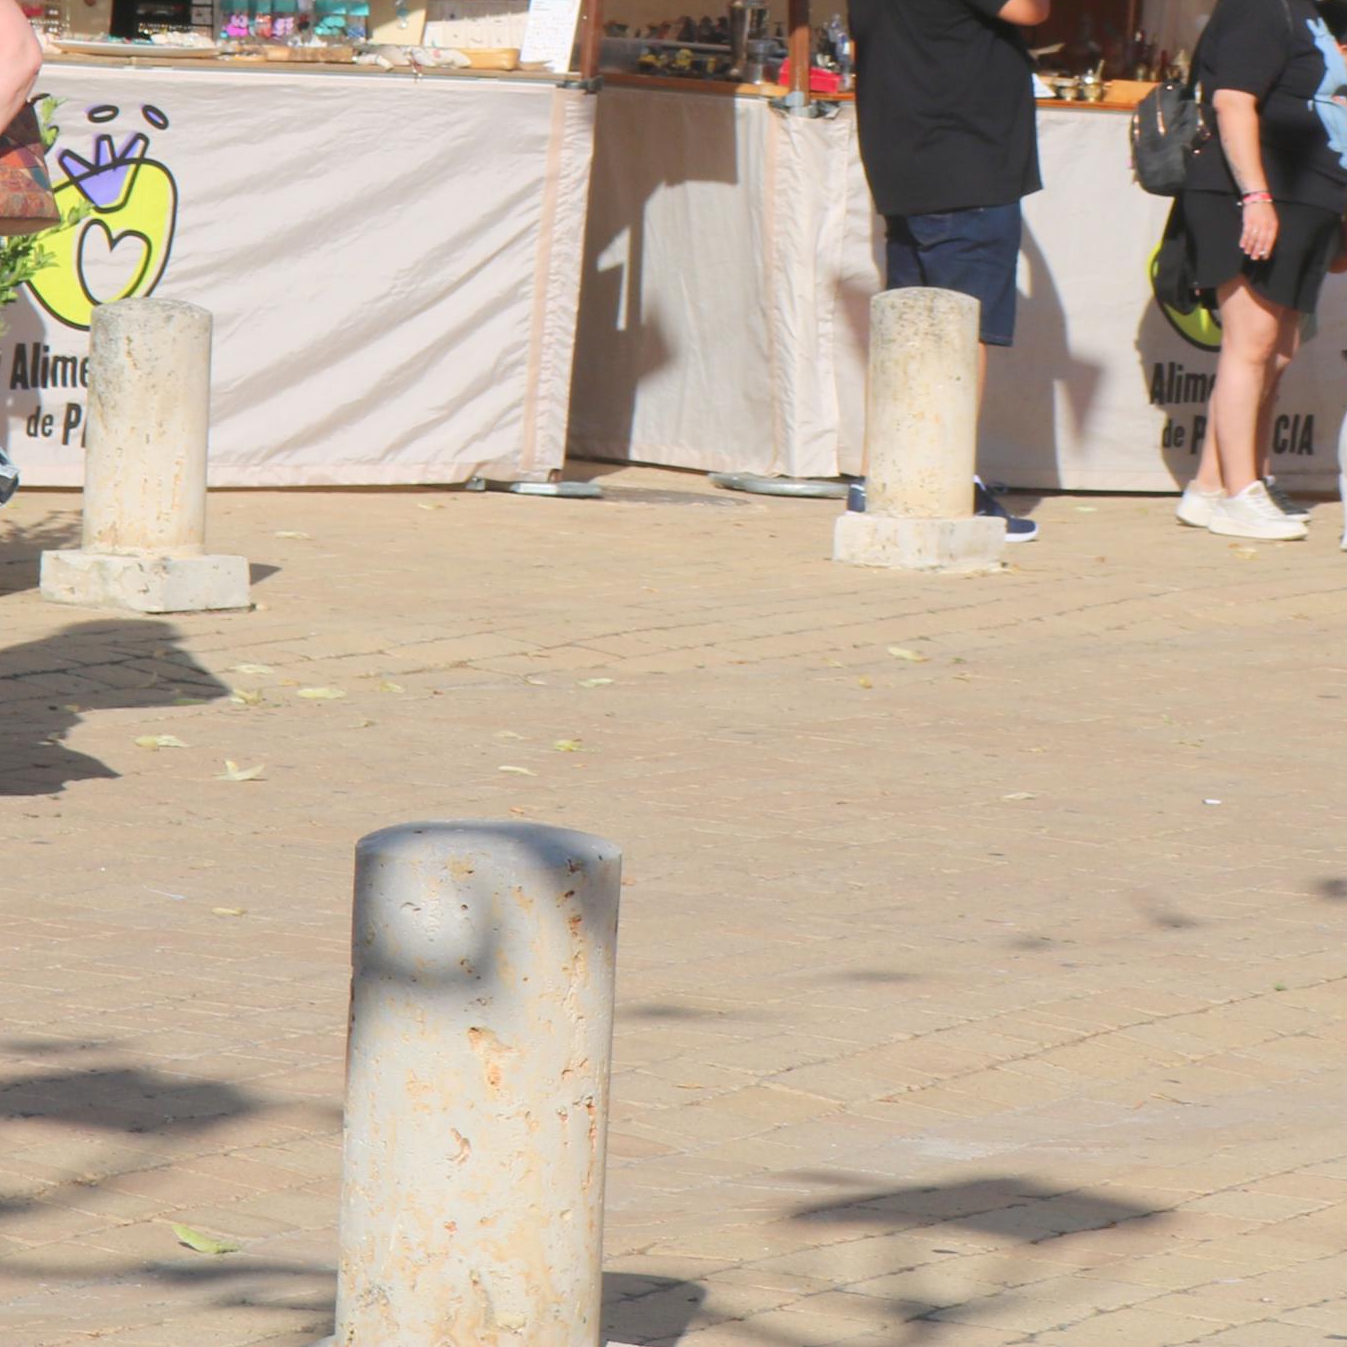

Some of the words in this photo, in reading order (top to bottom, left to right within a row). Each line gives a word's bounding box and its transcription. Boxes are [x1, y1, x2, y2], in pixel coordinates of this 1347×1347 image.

[9, 342, 90, 390] Alime
[26, 404, 54, 438] de
[1162, 418, 1186, 448] de
